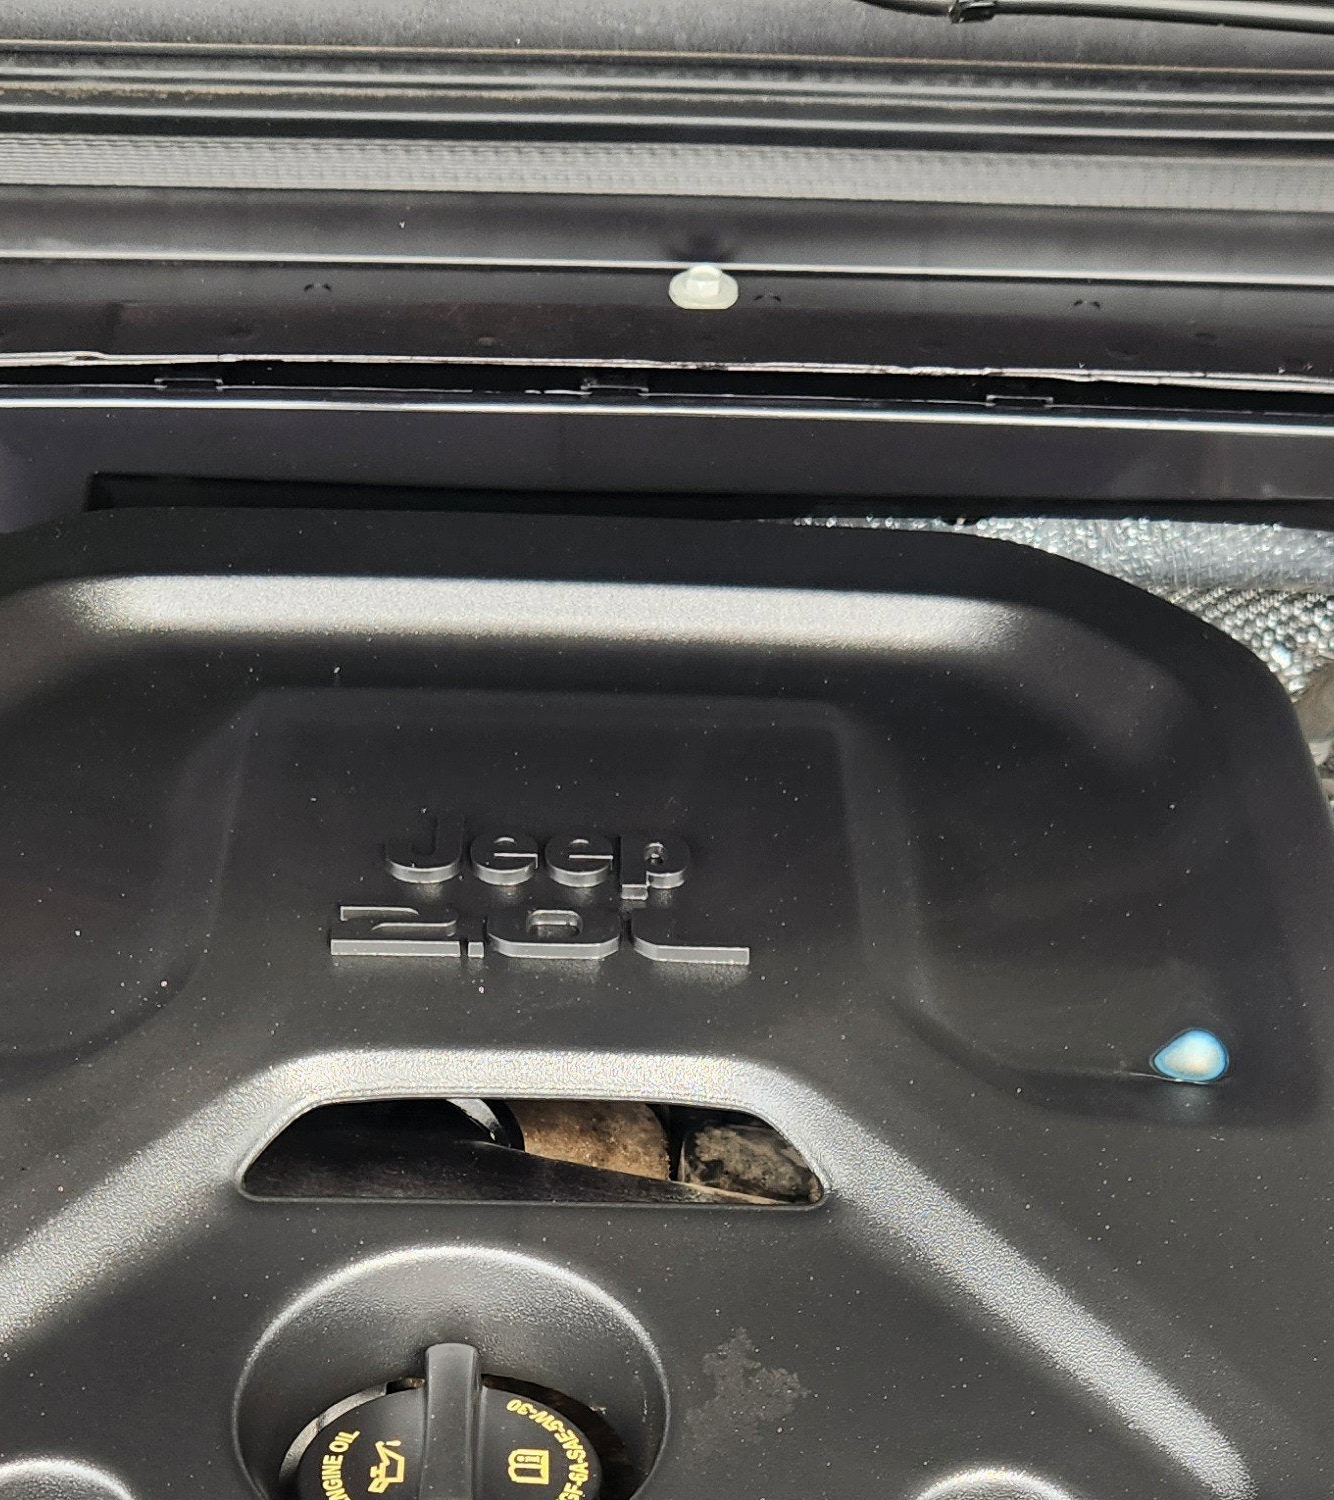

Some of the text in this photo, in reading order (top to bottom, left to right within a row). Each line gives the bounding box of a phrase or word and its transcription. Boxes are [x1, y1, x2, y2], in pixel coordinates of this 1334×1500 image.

[384, 814, 692, 900] Jeep
[330, 901, 750, 965] 2.0L
[329, 1430, 360, 1453] OIL
